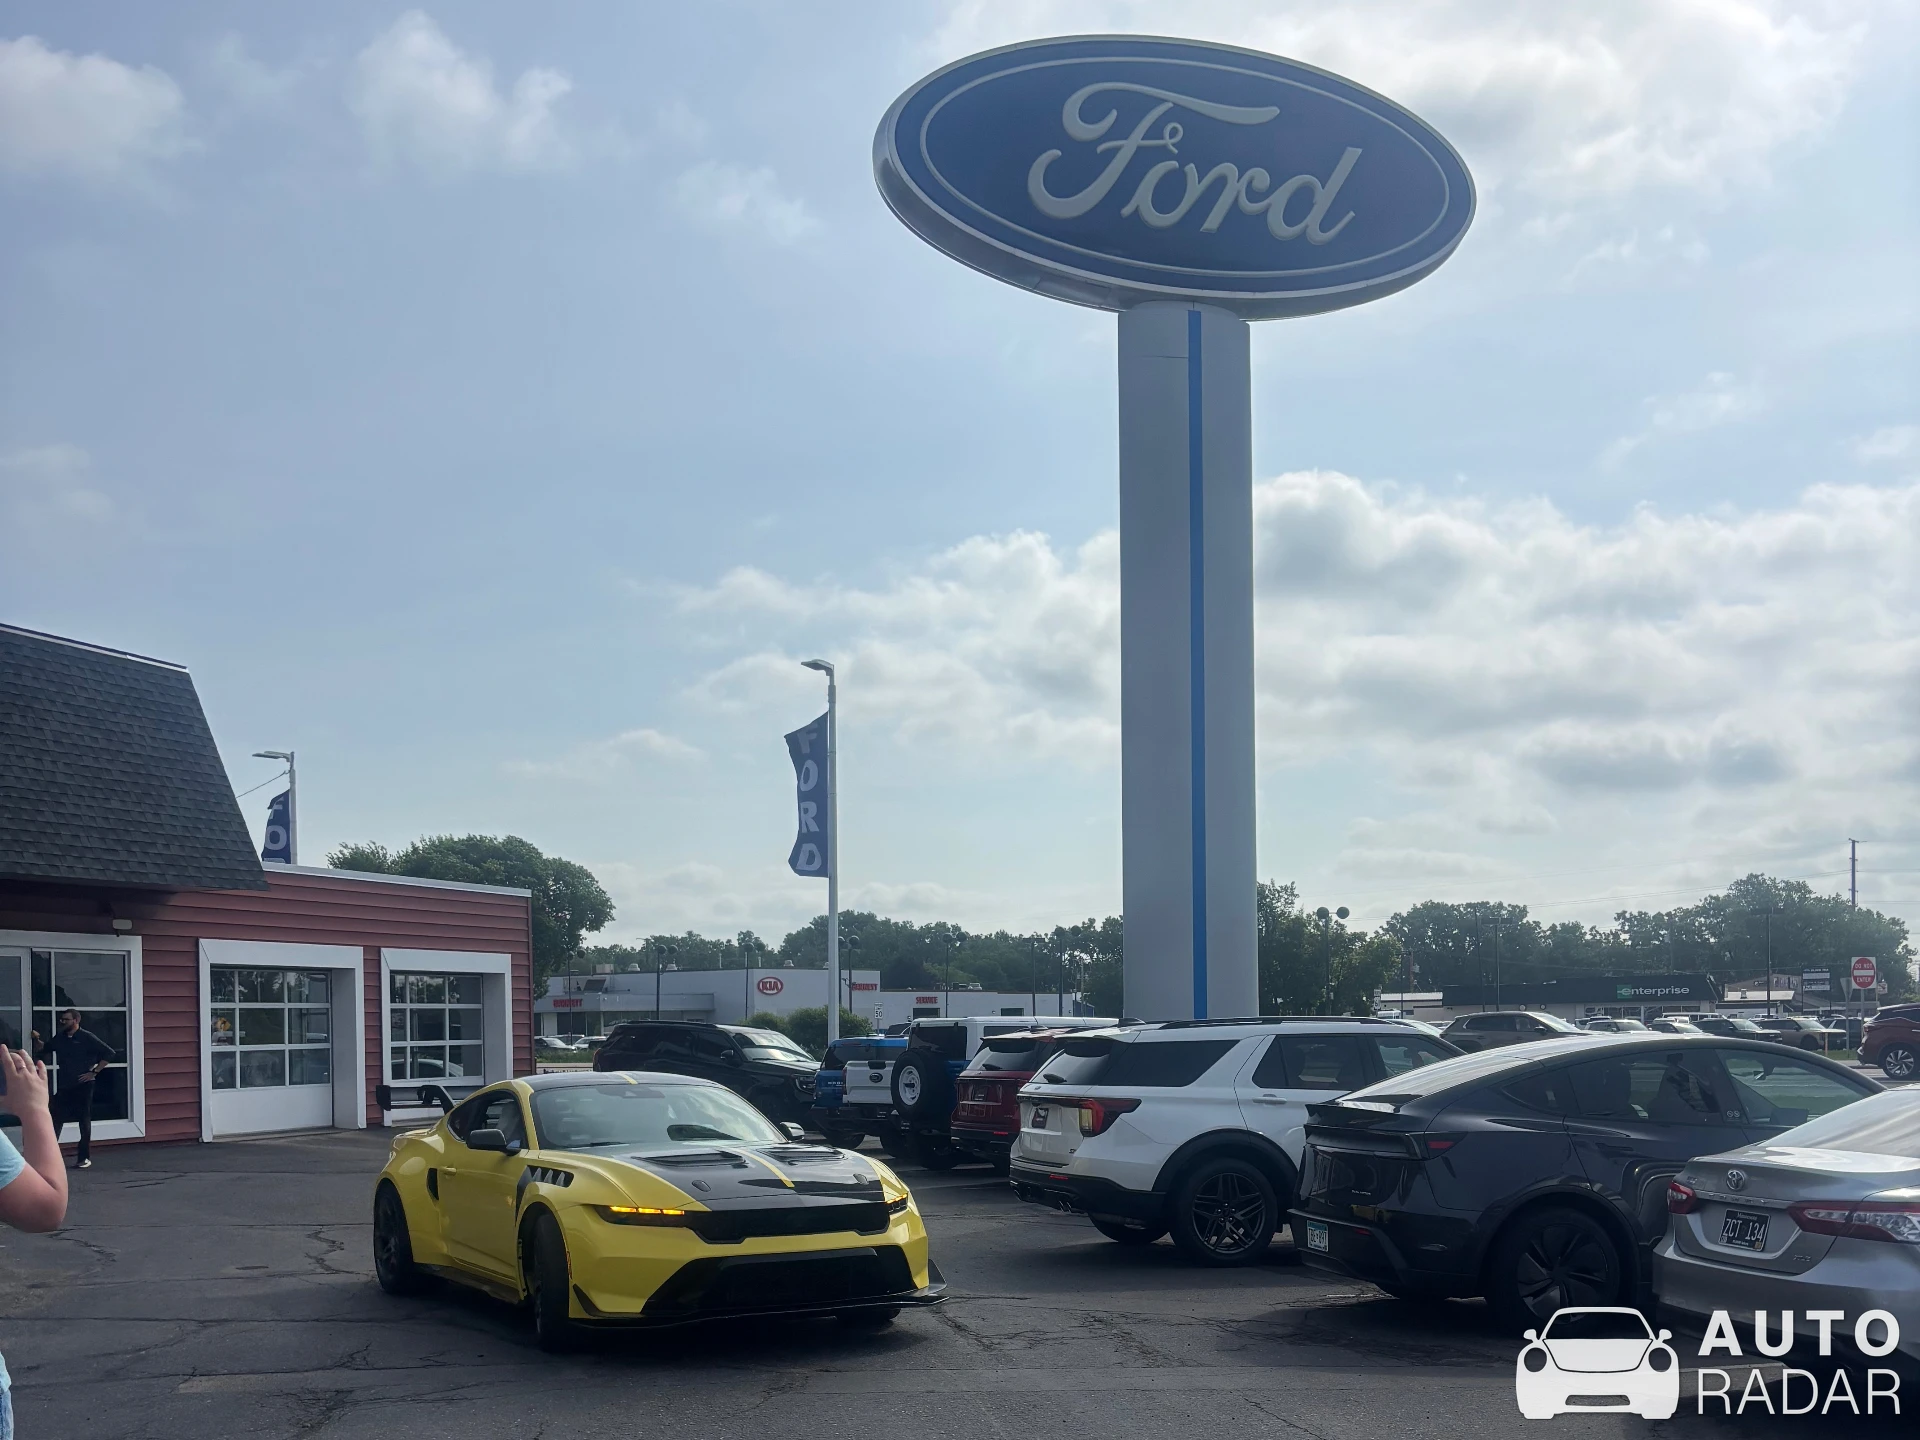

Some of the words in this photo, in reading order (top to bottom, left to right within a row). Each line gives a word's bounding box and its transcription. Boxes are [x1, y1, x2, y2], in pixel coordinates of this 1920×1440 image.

[1027, 81, 1362, 245] Ford
[796, 723, 822, 871] FORD
[264, 796, 288, 863] FO
[762, 981, 779, 992] KIA
[1617, 986, 1690, 996] enterprise
[875, 1010, 883, 1018] 50
[1722, 1218, 1743, 1238] ZCT
[1745, 1222, 1766, 1242] 134
